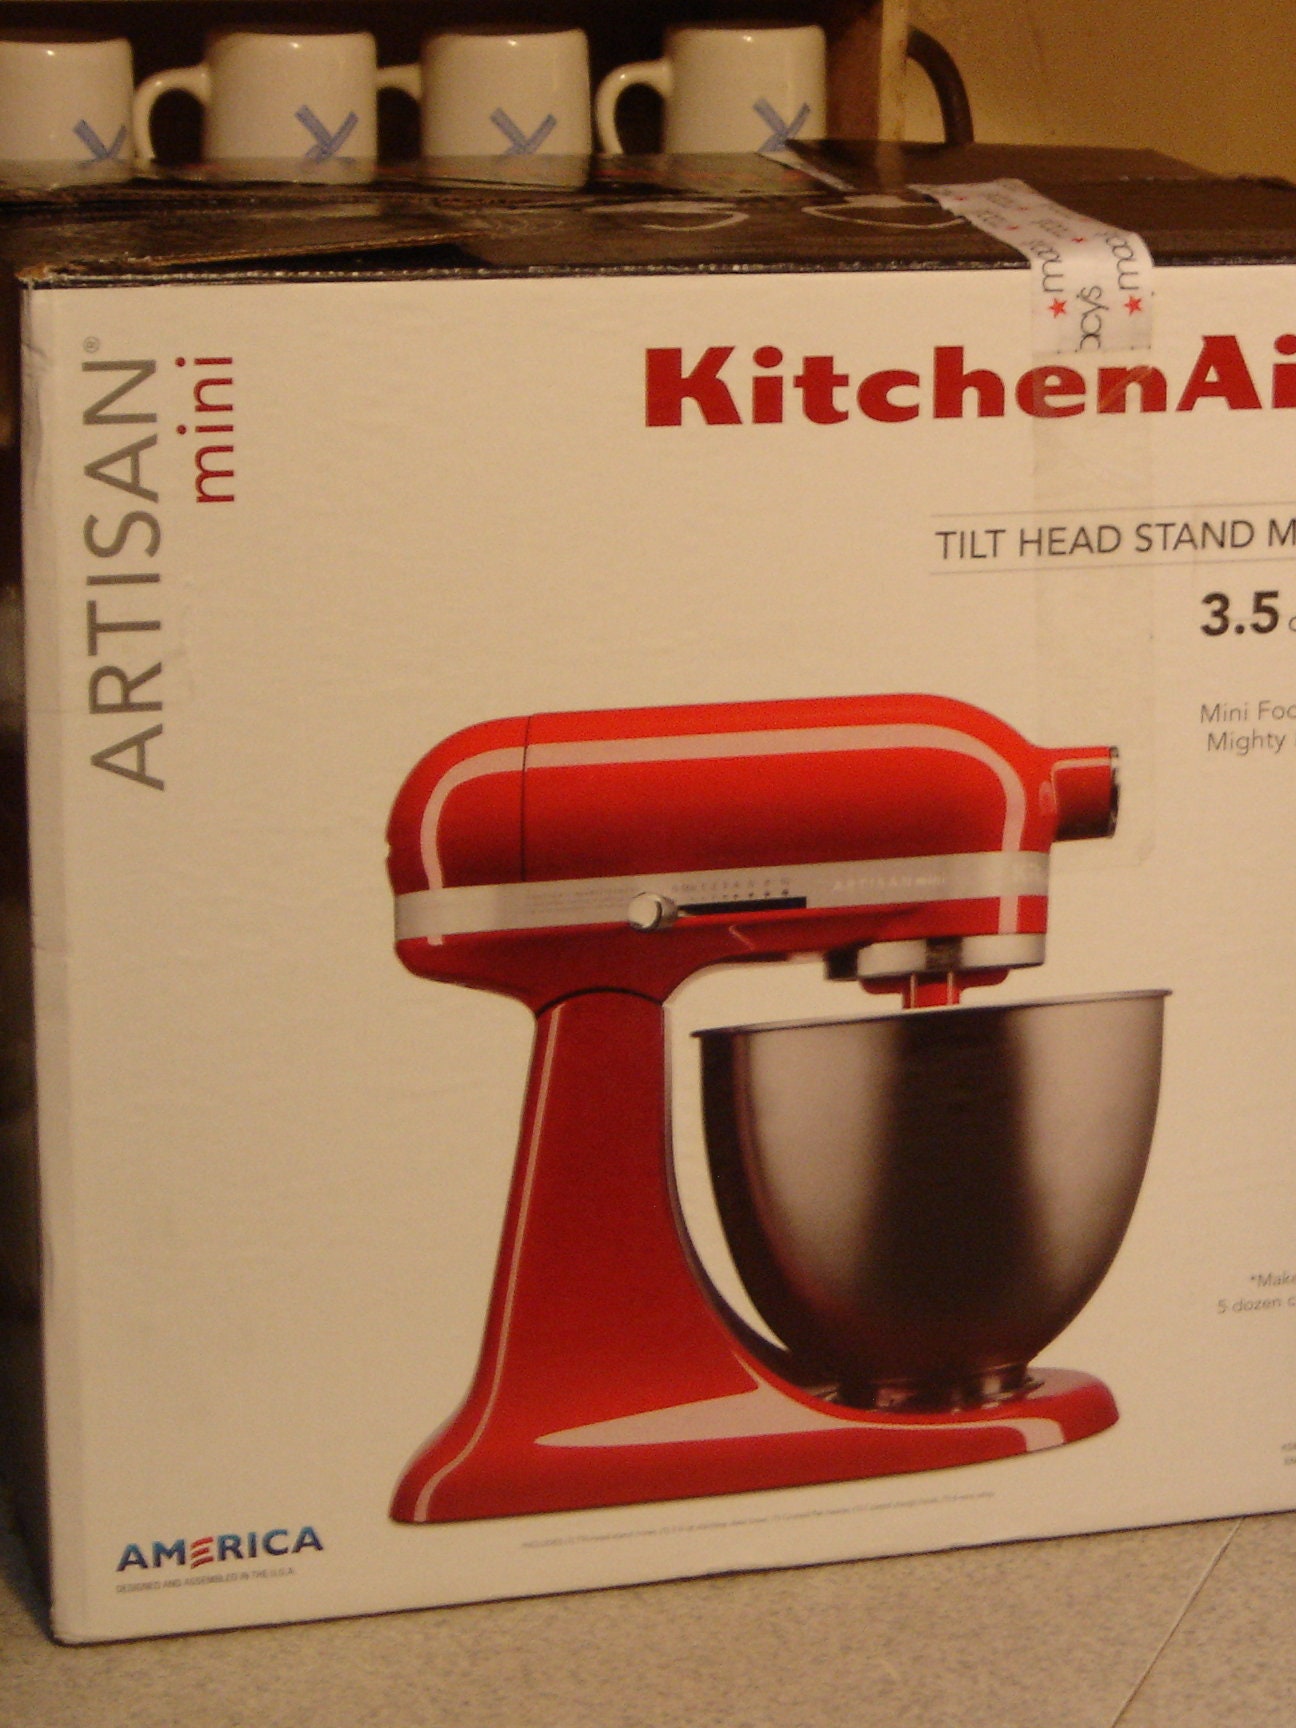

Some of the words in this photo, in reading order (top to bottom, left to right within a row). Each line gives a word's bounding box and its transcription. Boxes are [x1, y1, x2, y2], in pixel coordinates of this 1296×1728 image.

[174, 355, 235, 504] mini
[935, 528, 1006, 560] TILT
[1018, 524, 1122, 558] HEAD
[1134, 519, 1255, 552] STAND
[1200, 590, 1280, 637] 3.5
[1200, 702, 1249, 724] Mini
[1207, 728, 1287, 756] Mighty
[1216, 1299, 1228, 1315] 5
[1231, 1298, 1283, 1313] dozen
[115, 1525, 324, 1572] AMERICA
